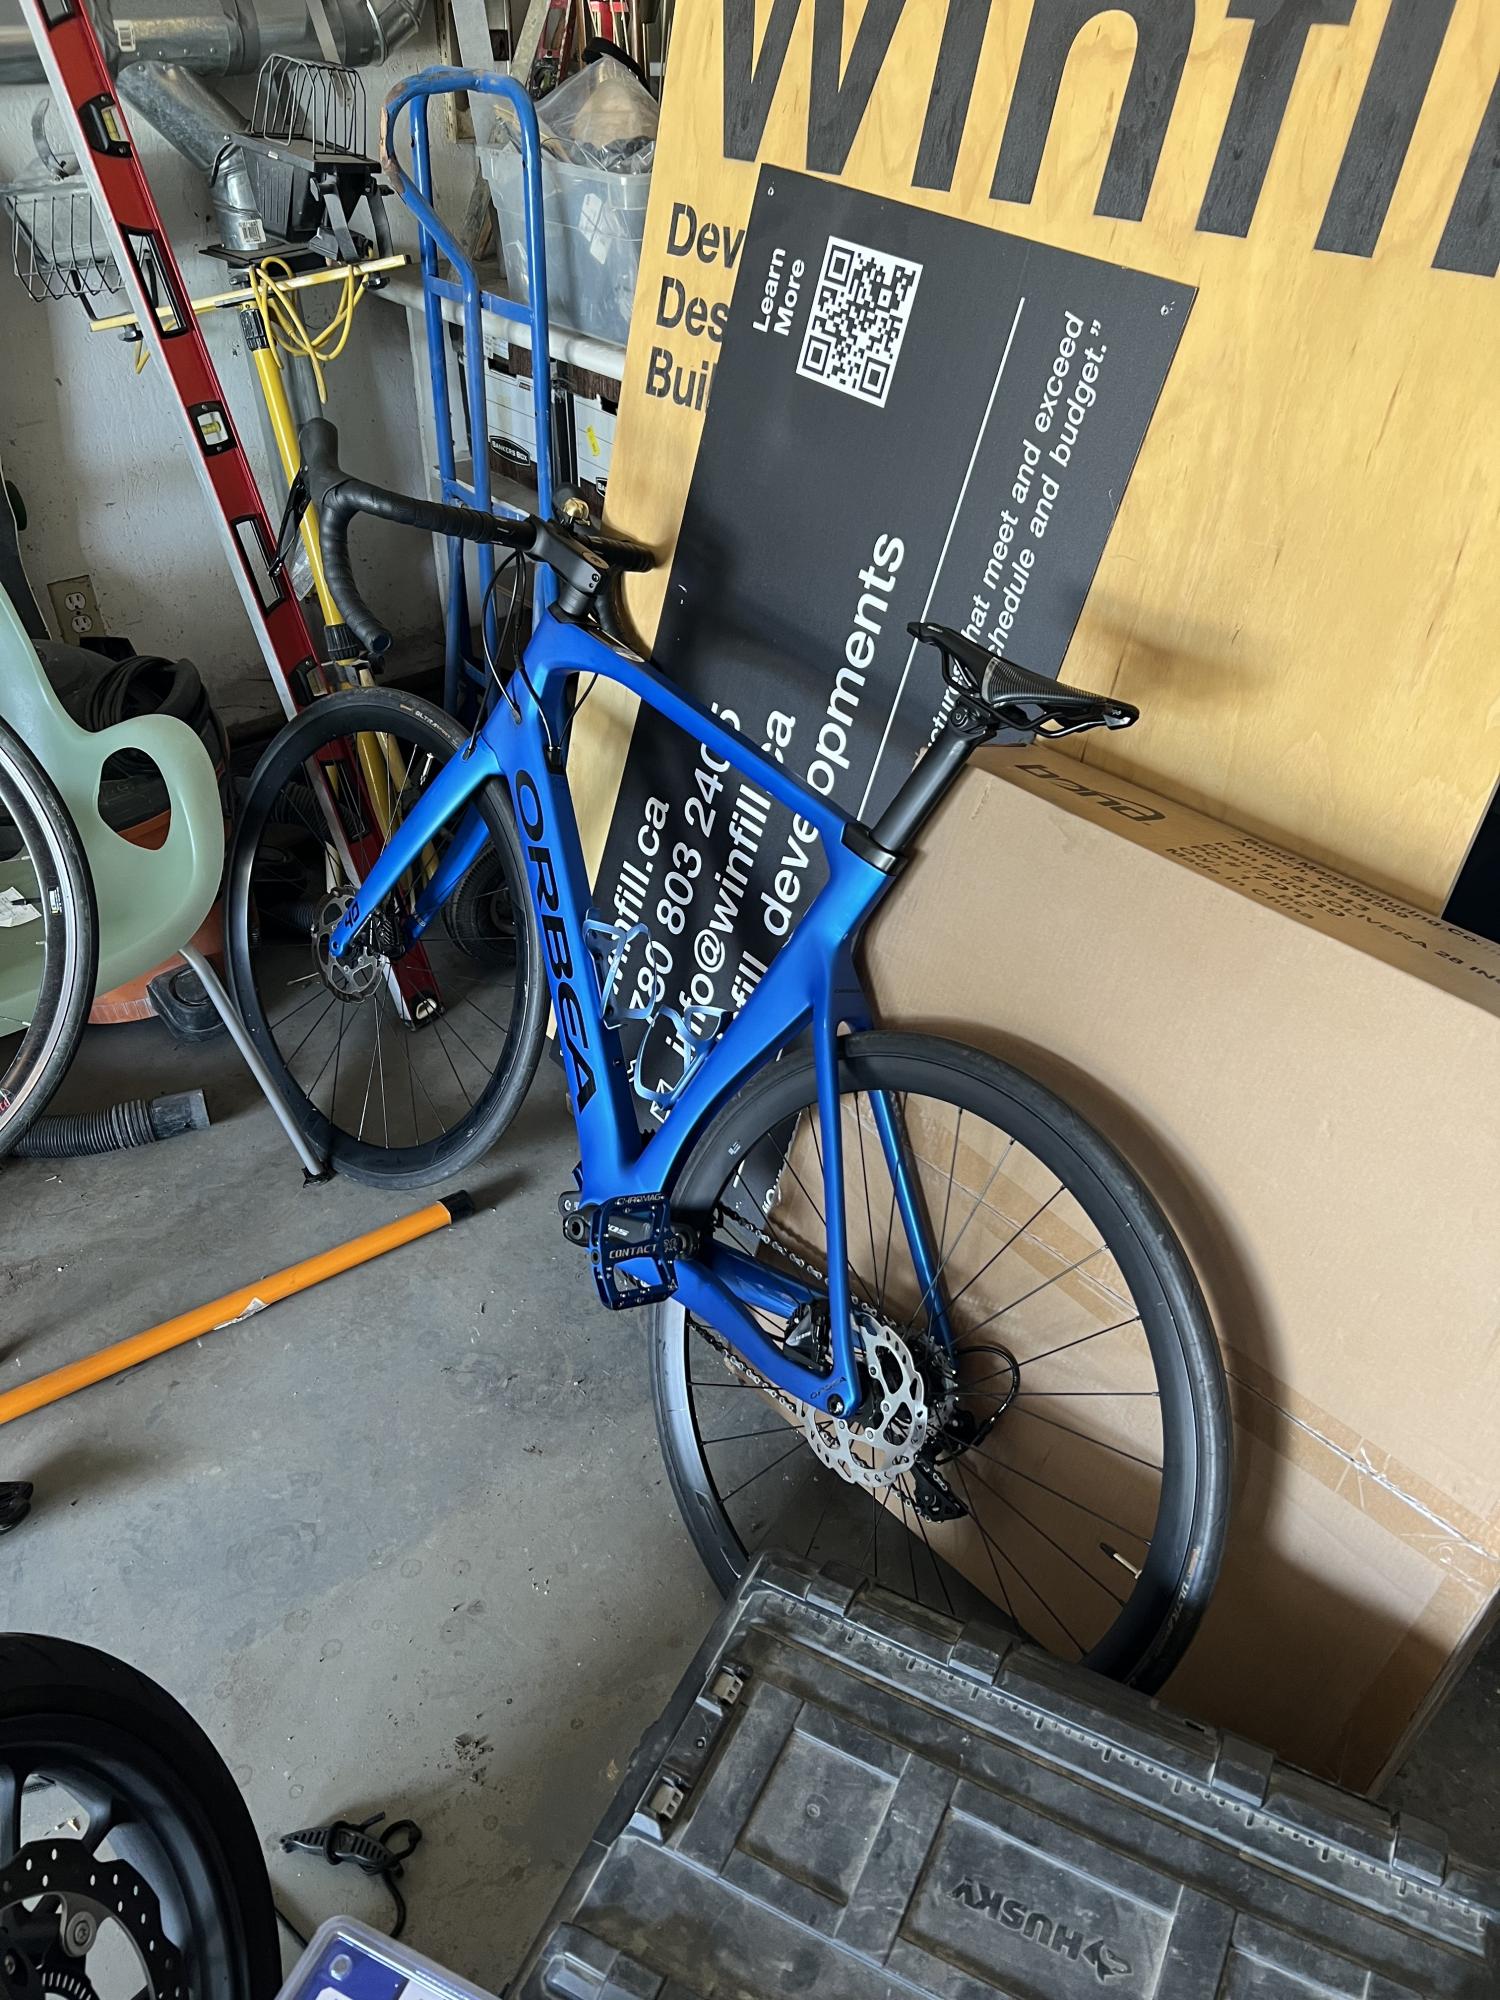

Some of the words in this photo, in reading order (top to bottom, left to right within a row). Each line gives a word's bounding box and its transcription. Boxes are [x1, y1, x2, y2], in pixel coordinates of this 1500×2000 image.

[666, 201, 747, 270] Dev
[655, 275, 730, 343] Des
[752, 248, 787, 333] Learn
[773, 258, 805, 337] More
[961, 594, 991, 644] hat
[983, 509, 1020, 585] meet
[1011, 439, 1042, 505] and
[1034, 310, 1085, 434] exceed
[987, 548, 1036, 657] chedule
[1030, 473, 1061, 539] and
[760, 533, 905, 936] deveopments
[656, 842, 702, 935] 803
[1165, 848, 1220, 875] Made
[1225, 876, 1246, 887] in
[1251, 888, 1315, 920] China
[1298, 862, 1445, 930] Manufacturing
[514, 769, 598, 1115] ORBEA
[1434, 950, 1465, 965] 28
[1468, 966, 1500, 985] IN
[608, 1243, 657, 1260] CONTACT
[949, 1876, 1084, 1961] HUSKY
